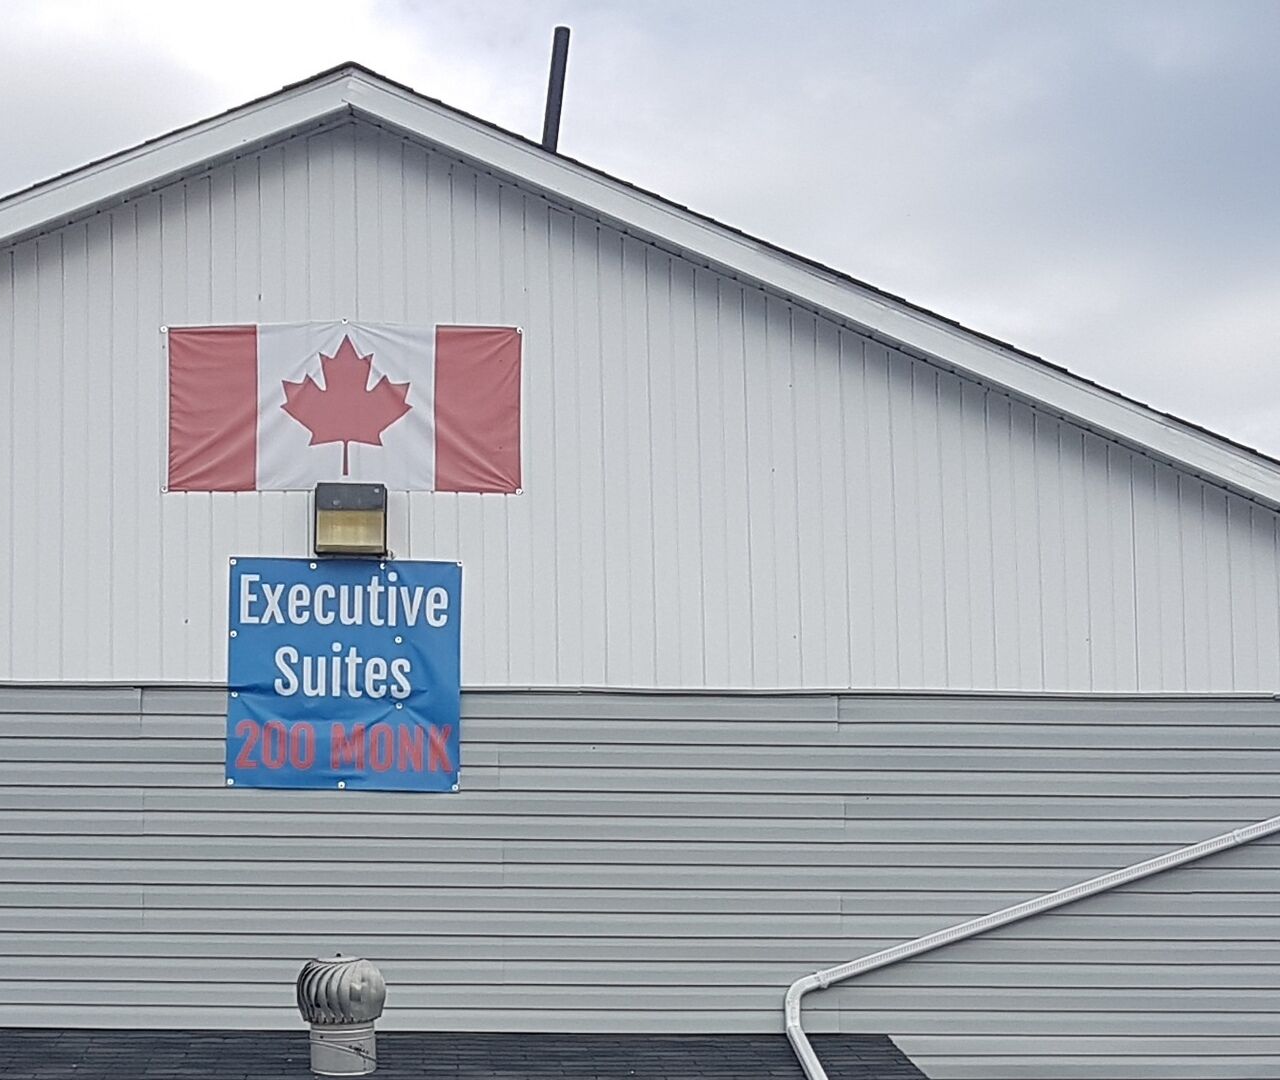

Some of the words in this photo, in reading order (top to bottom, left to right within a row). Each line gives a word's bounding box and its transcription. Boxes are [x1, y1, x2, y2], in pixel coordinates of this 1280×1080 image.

[239, 571, 449, 628] Executive
[273, 642, 411, 699] Suites
[234, 720, 315, 769] 200
[330, 722, 454, 774] MONK
